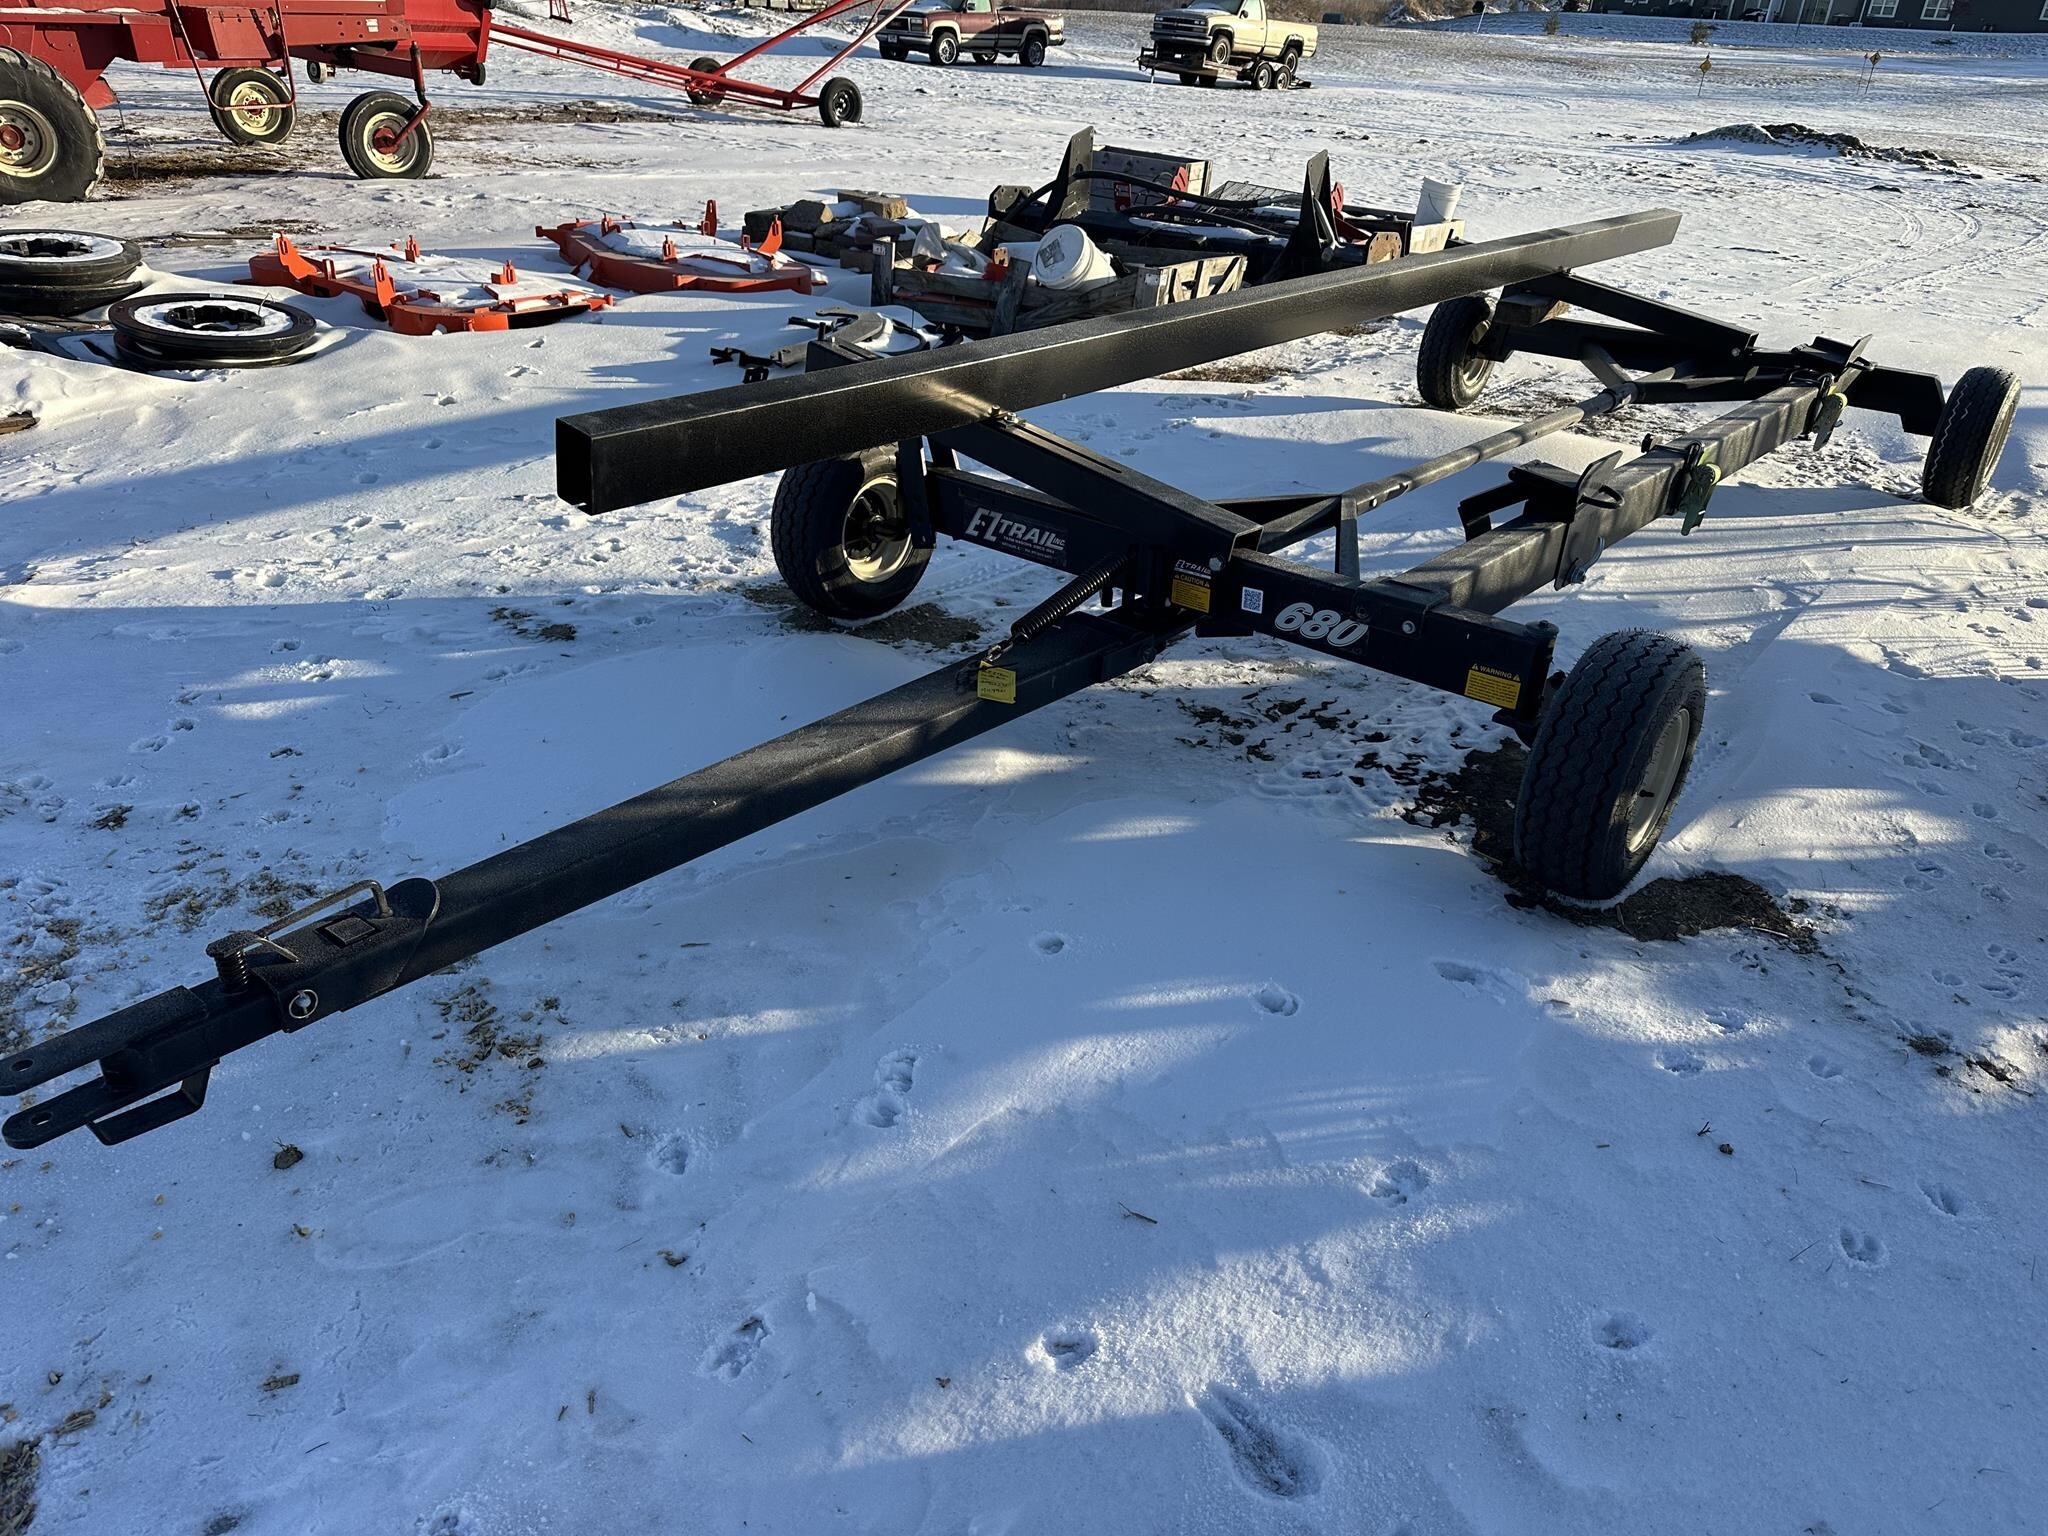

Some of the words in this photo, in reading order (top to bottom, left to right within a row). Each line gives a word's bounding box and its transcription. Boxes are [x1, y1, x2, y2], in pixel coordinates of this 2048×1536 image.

[1180, 574, 1204, 586] CAUTION
[1275, 602, 1369, 647] 680
[1480, 665, 1513, 679] WARNING
